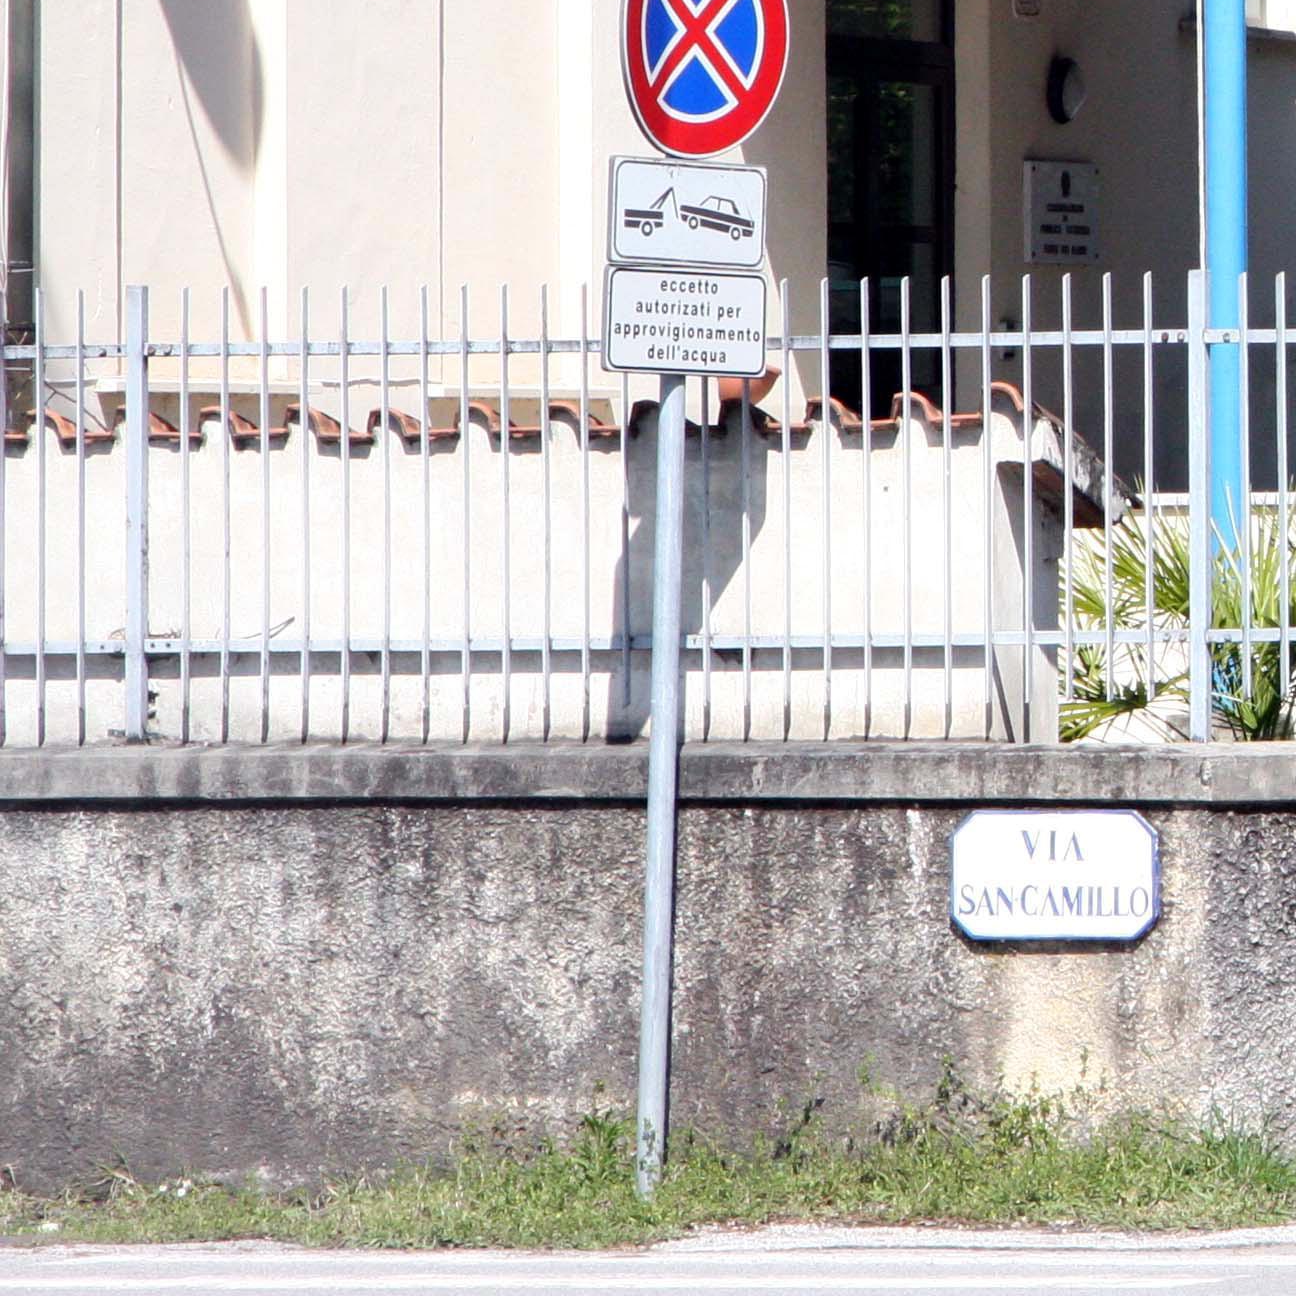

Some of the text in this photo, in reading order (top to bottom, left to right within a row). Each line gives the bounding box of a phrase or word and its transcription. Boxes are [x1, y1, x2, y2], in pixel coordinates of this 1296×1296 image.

[660, 279, 719, 295] eccetto
[635, 300, 742, 321] autorizati per
[614, 321, 760, 343] approvigionamento
[647, 344, 727, 366] dell'acqua
[1020, 829, 1085, 862] VIA
[1020, 884, 1150, 918] CAMILLO
